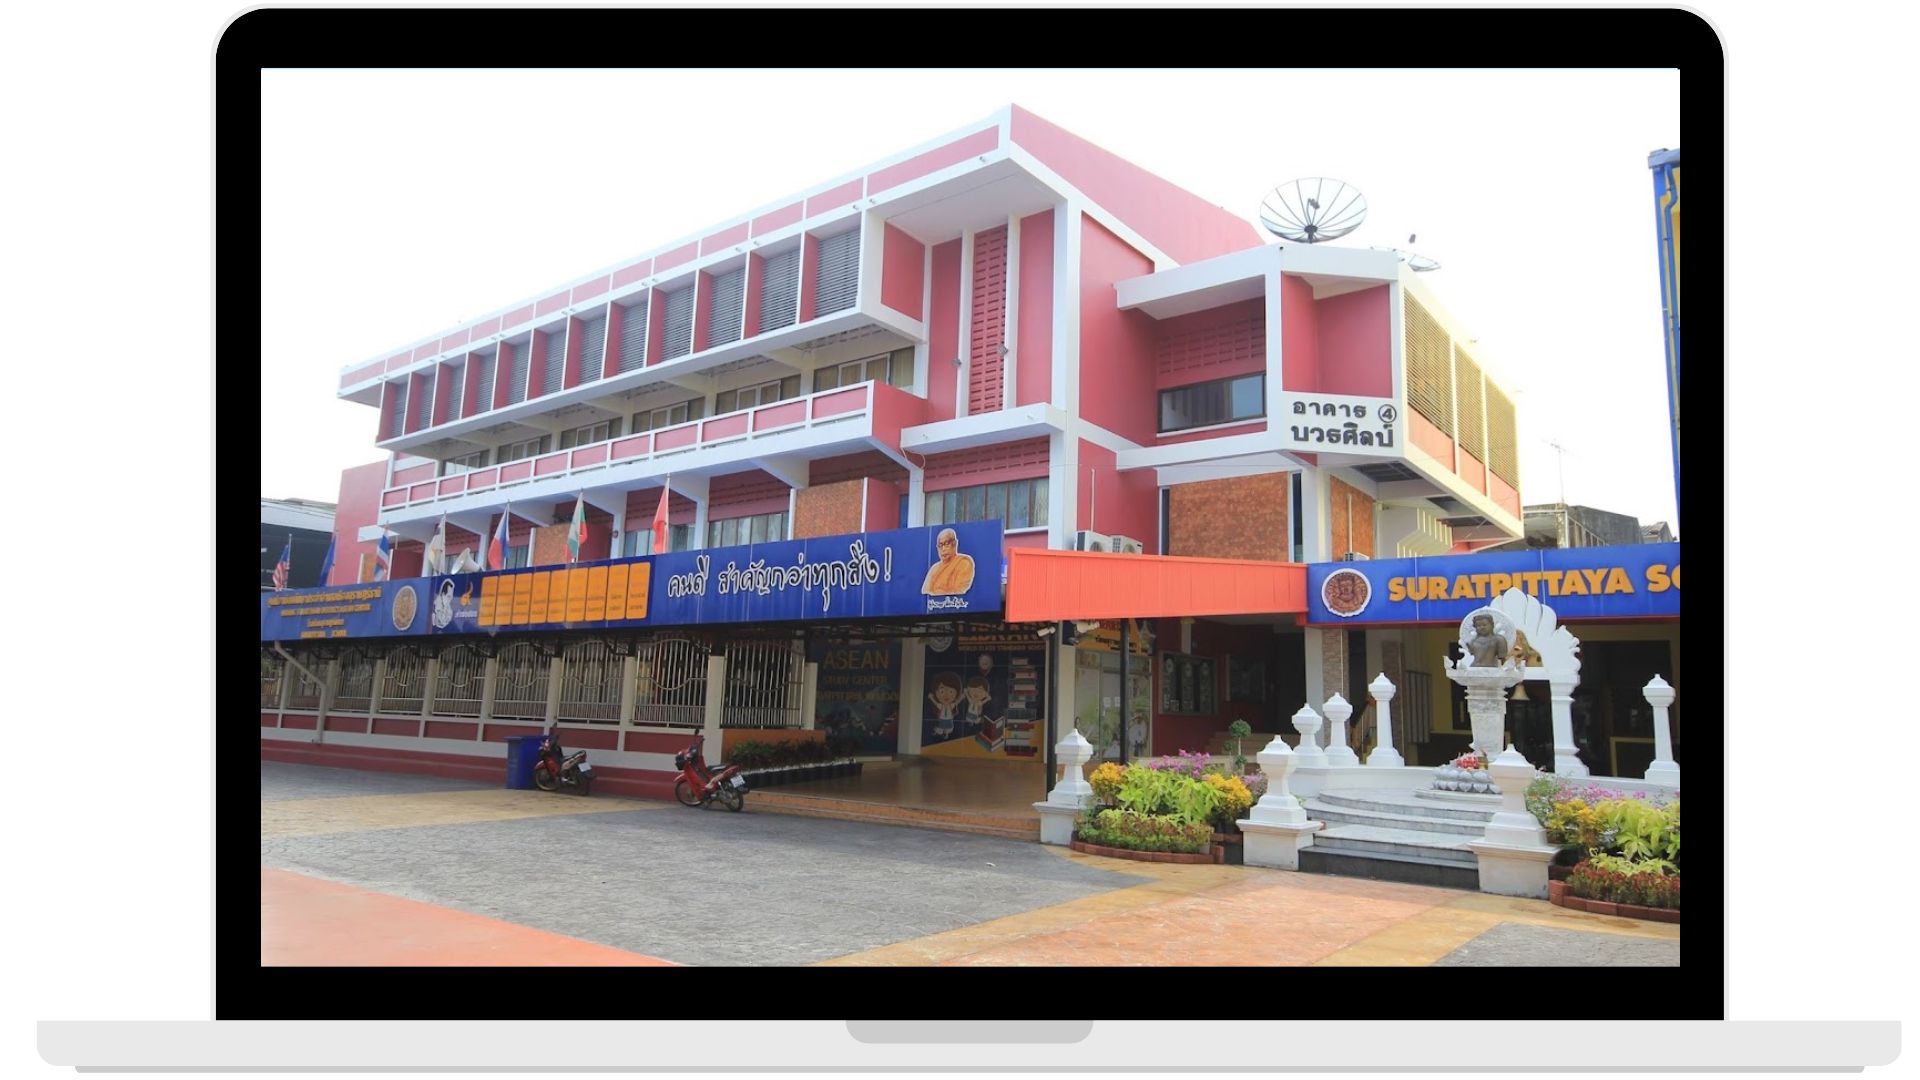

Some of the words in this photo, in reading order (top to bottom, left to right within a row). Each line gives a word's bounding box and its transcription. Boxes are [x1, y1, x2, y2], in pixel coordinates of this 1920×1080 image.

[1293, 401, 1366, 418] อาคาร
[668, 555, 710, 598] คนดี
[1387, 567, 1635, 602] SURATPITTAYA
[823, 649, 889, 670] ASEAN
